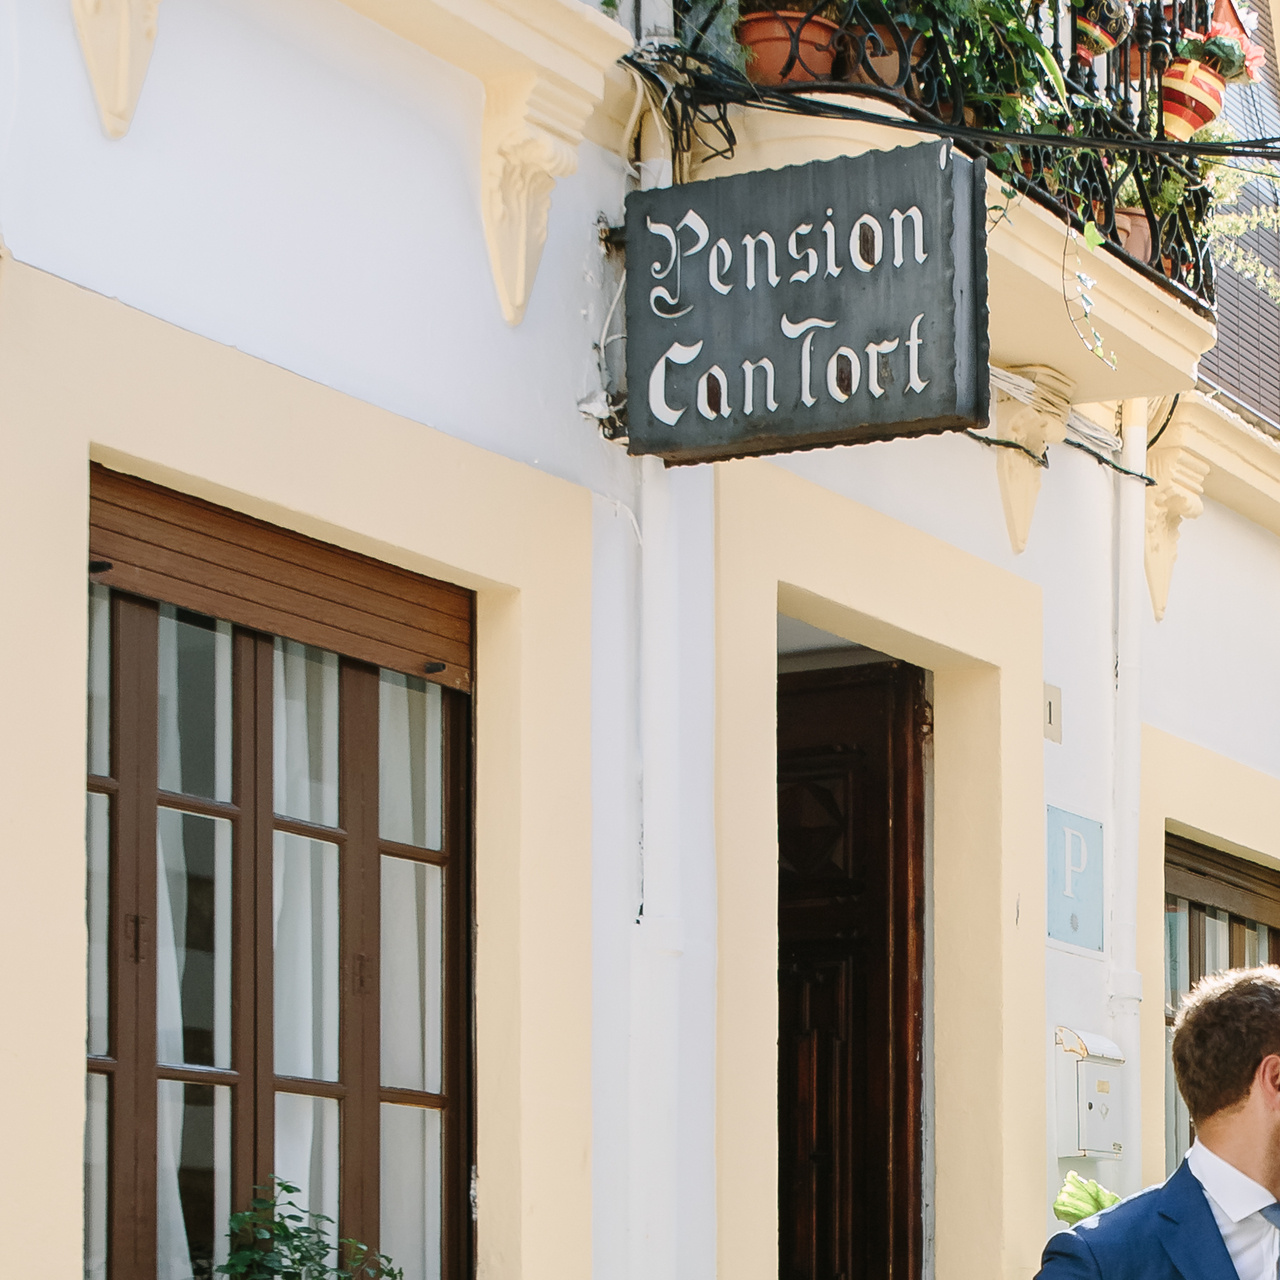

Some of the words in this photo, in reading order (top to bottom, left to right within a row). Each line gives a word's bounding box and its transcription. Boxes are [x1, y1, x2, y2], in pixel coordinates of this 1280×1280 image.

[647, 205, 929, 319] Pension
[648, 340, 780, 426] Can
[780, 313, 930, 408] Tort
[1062, 826, 1088, 898] P
